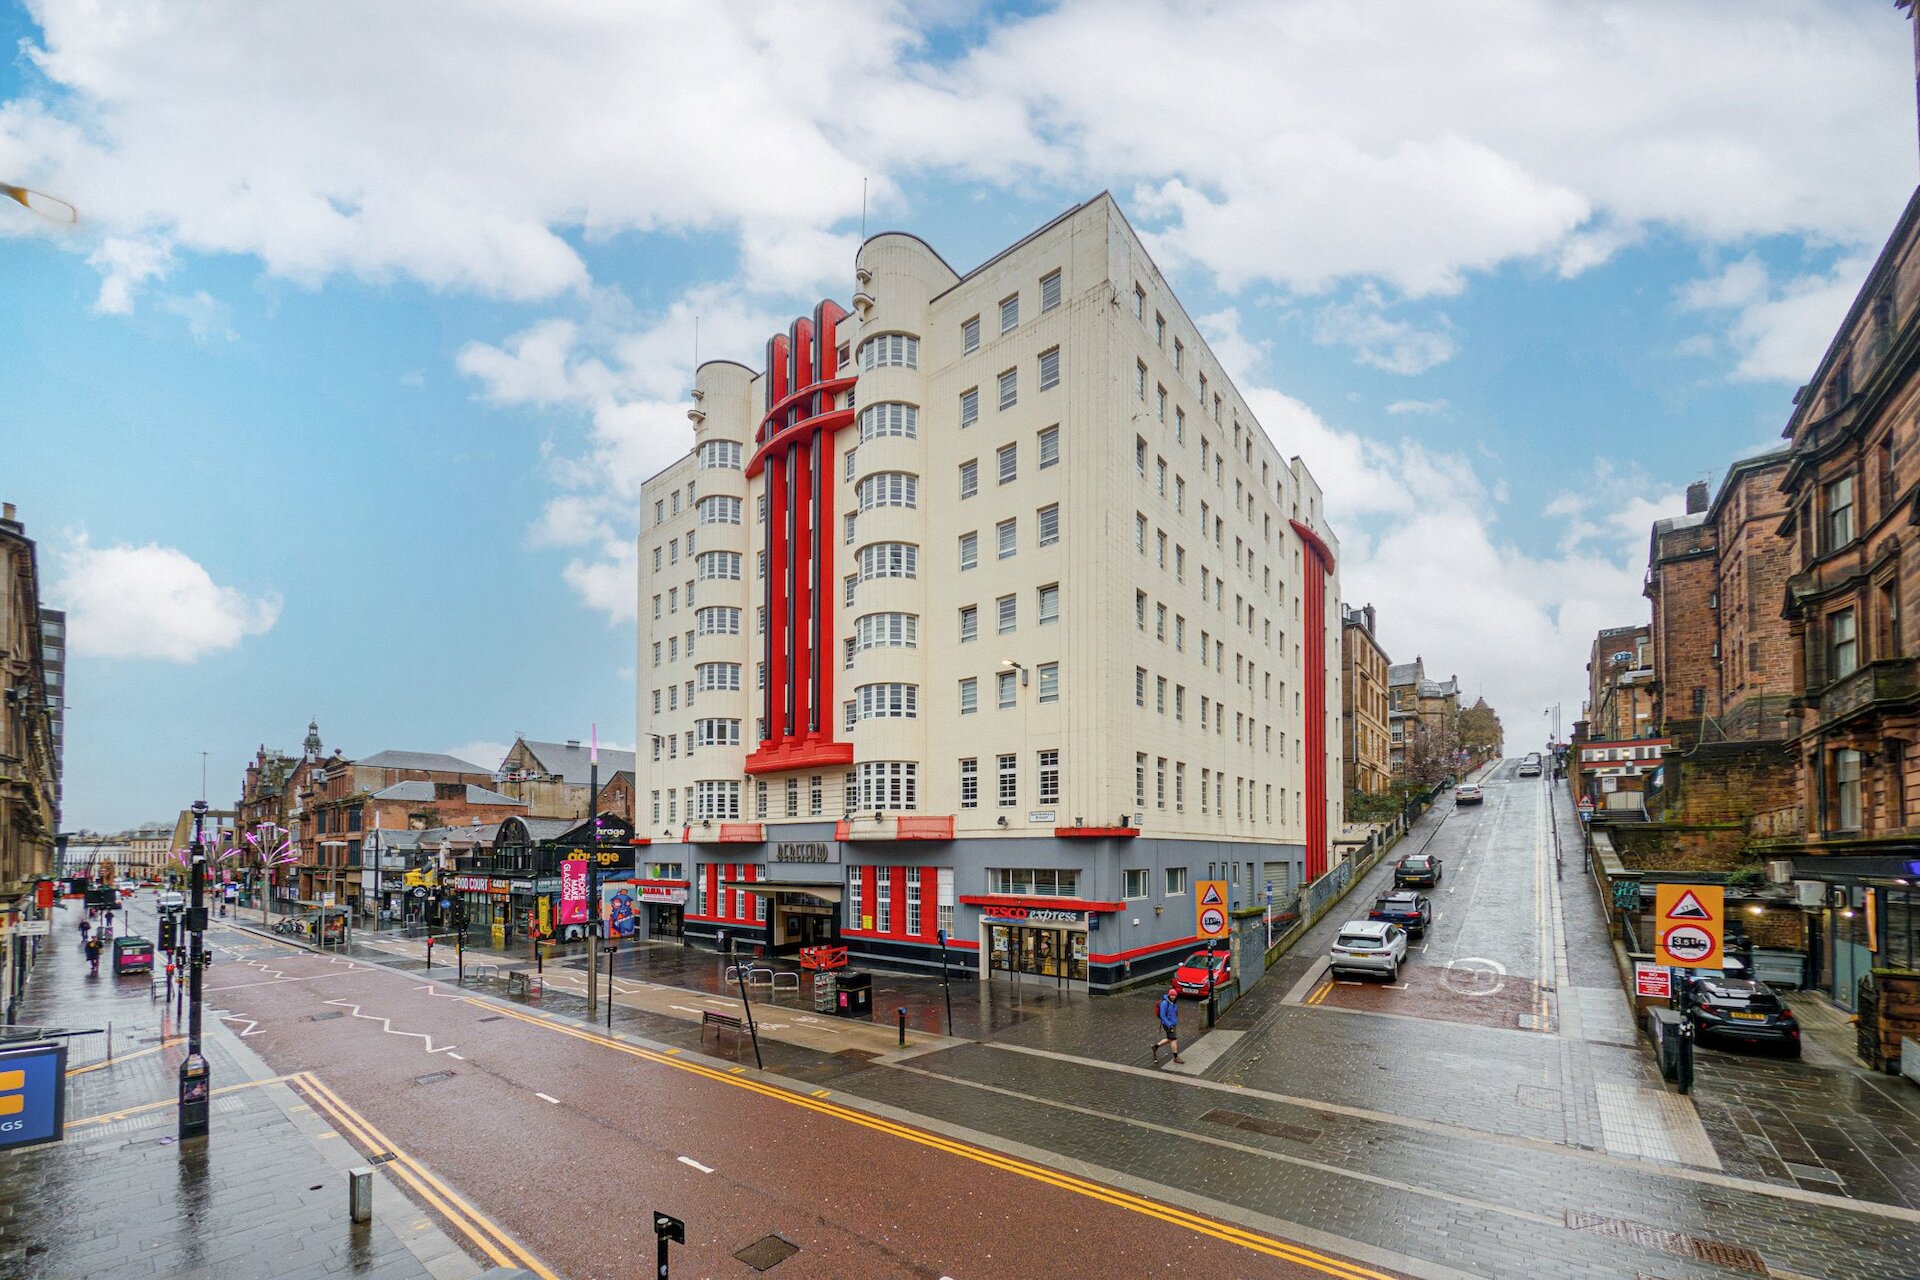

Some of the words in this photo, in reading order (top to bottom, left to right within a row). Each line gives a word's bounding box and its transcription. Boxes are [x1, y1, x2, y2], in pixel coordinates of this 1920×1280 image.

[777, 843, 828, 863] BERESFORD
[455, 878, 468, 890] FOOD
[469, 878, 488, 891] COURT
[563, 863, 571, 901] GLASGOW
[578, 873, 586, 900] PEOPLE
[984, 906, 1028, 919] TESCO
[1029, 909, 1077, 922] express
